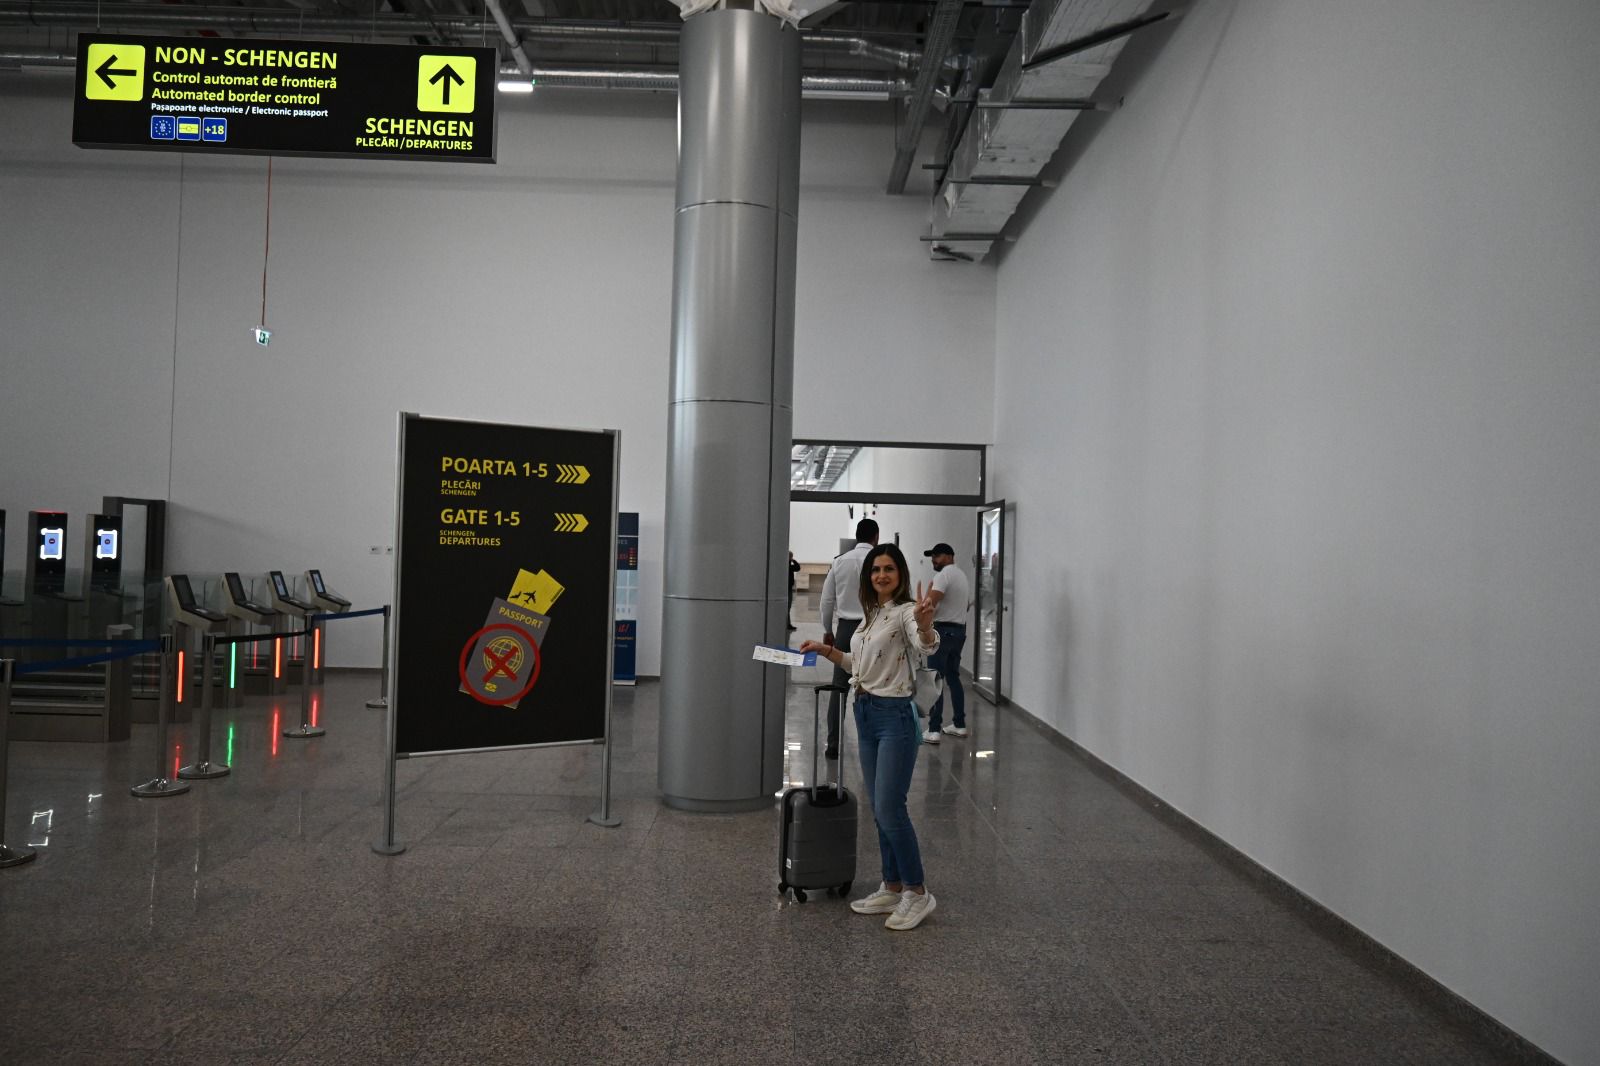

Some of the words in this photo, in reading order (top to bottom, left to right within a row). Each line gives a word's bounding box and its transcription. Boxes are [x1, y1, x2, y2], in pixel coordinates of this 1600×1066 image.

[155, 46, 206, 65] NON
[223, 48, 338, 70] SCHENGEN
[152, 71, 201, 84] Control
[203, 74, 259, 86] automat
[261, 74, 278, 87] de
[280, 74, 337, 89] frontieră
[151, 87, 225, 102] Automated
[228, 89, 272, 103] border
[274, 92, 320, 105] control
[198, 104, 244, 114] electronice
[251, 106, 292, 116] Electronic
[292, 108, 329, 119] passport
[204, 124, 225, 136] +18
[365, 117, 474, 138] SCHENGEN
[441, 456, 517, 476] POARTA
[522, 462, 548, 478] 1-5
[440, 488, 477, 496] SCHENGEN
[441, 479, 481, 490] PLECĂRI
[440, 508, 488, 525] GATE
[494, 510, 521, 526] 1-5
[439, 529, 475, 537] SCHENGEN
[439, 536, 501, 546] DEPARTURES
[498, 606, 543, 629] PASSPORT
